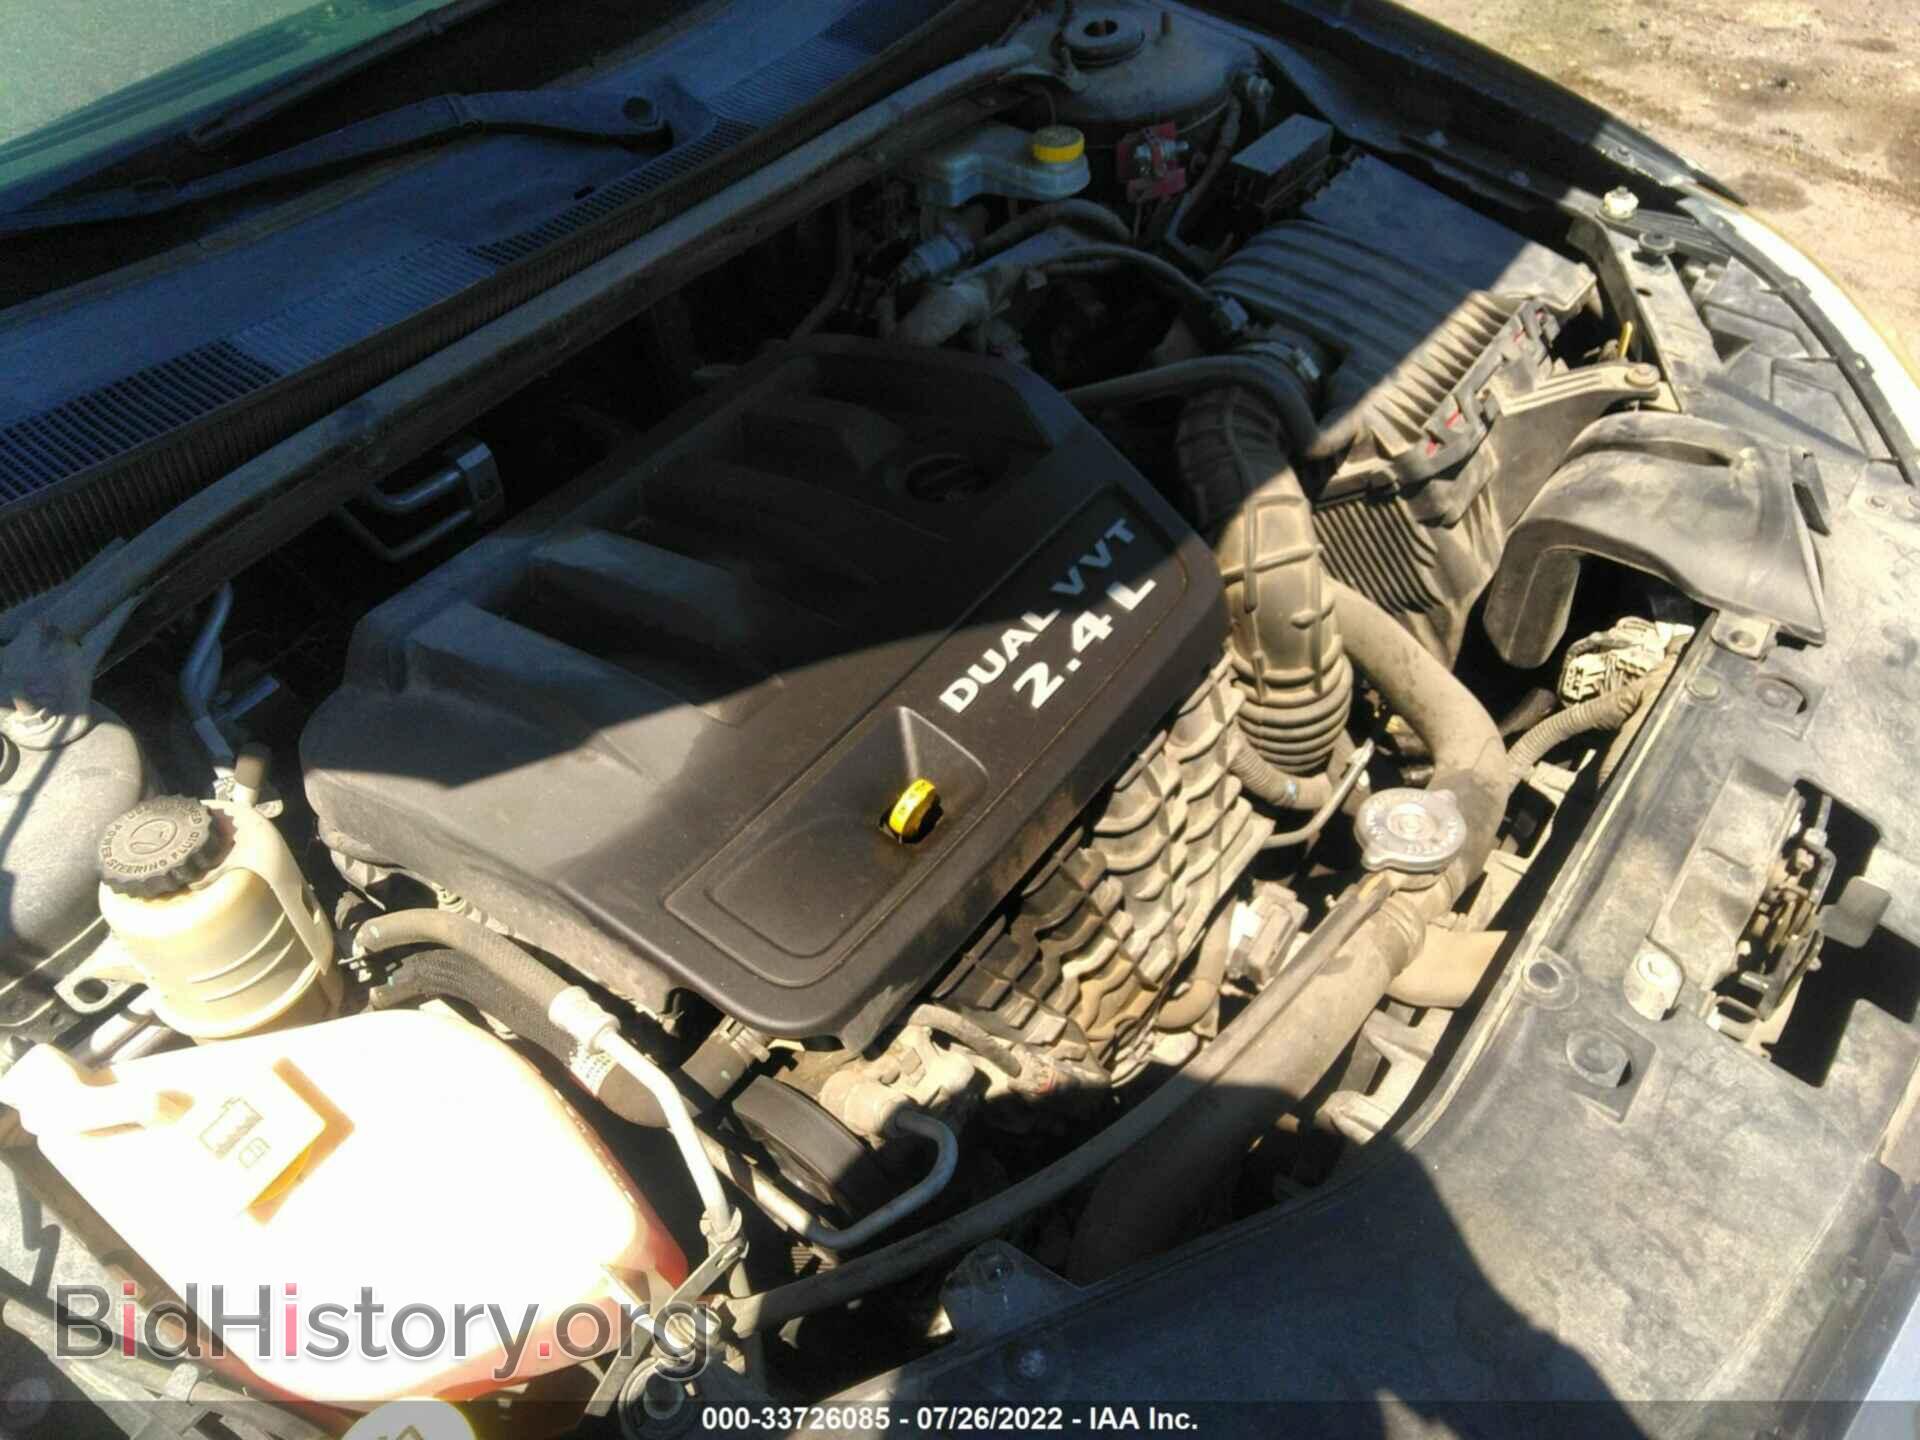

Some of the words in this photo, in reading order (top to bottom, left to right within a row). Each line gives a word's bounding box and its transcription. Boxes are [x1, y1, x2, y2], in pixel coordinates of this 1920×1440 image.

[940, 609, 1061, 712] DUAL
[1051, 518, 1135, 595] VVT
[106, 858, 168, 874] STEERING
[171, 831, 200, 860] FLUID
